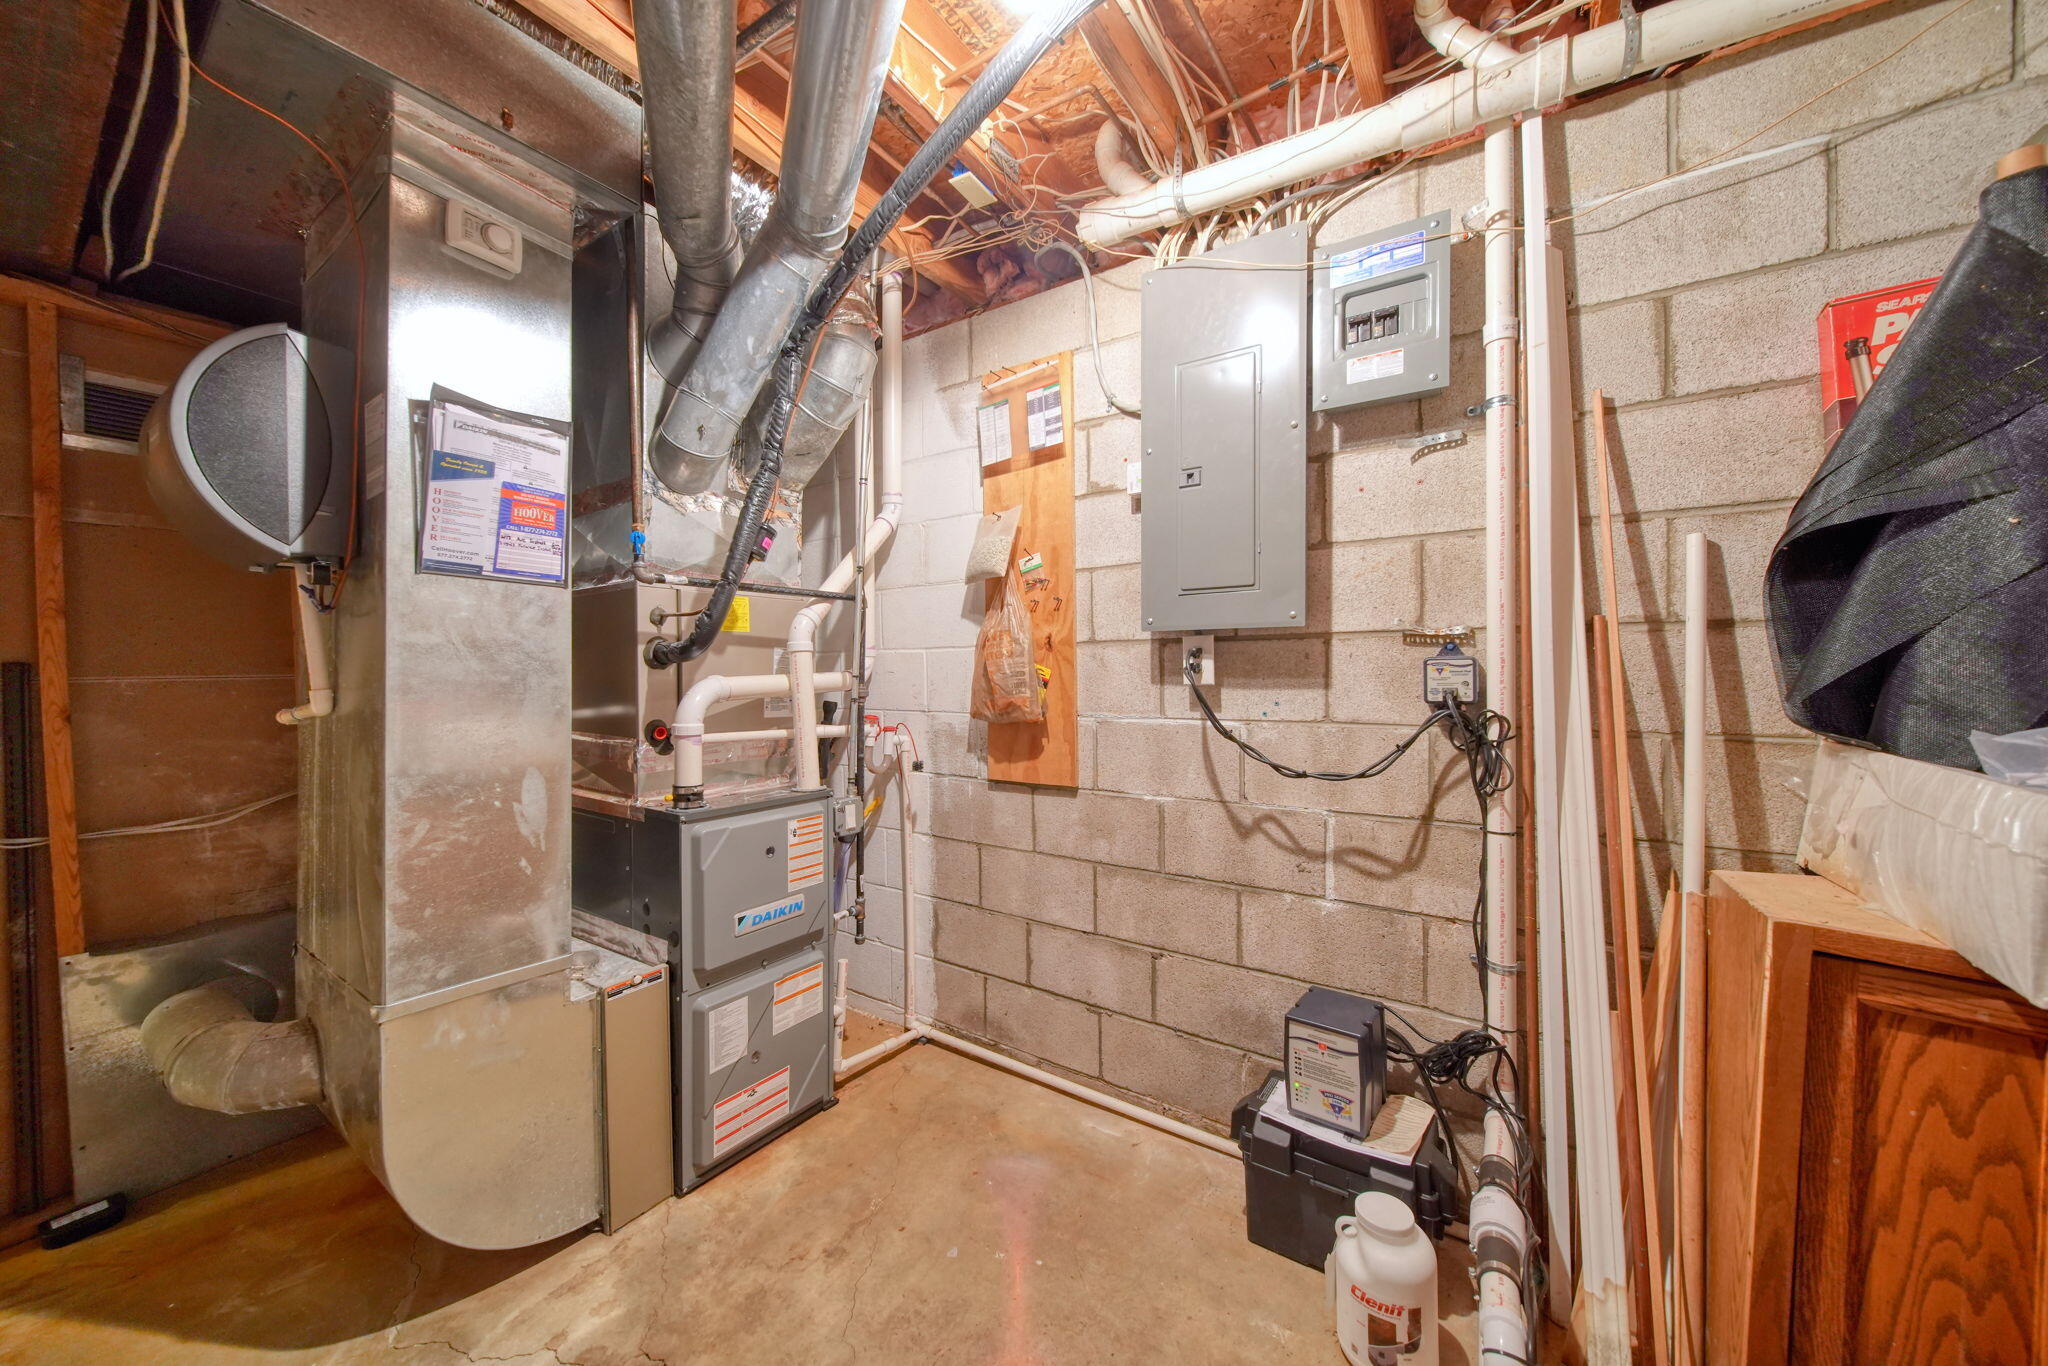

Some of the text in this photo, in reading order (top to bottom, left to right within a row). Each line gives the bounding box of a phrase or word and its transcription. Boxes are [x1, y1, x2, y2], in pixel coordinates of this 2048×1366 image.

[514, 508, 556, 523] HOOVER
[431, 545, 480, 556] CallHoover.com
[752, 900, 803, 926] DAIKIN
